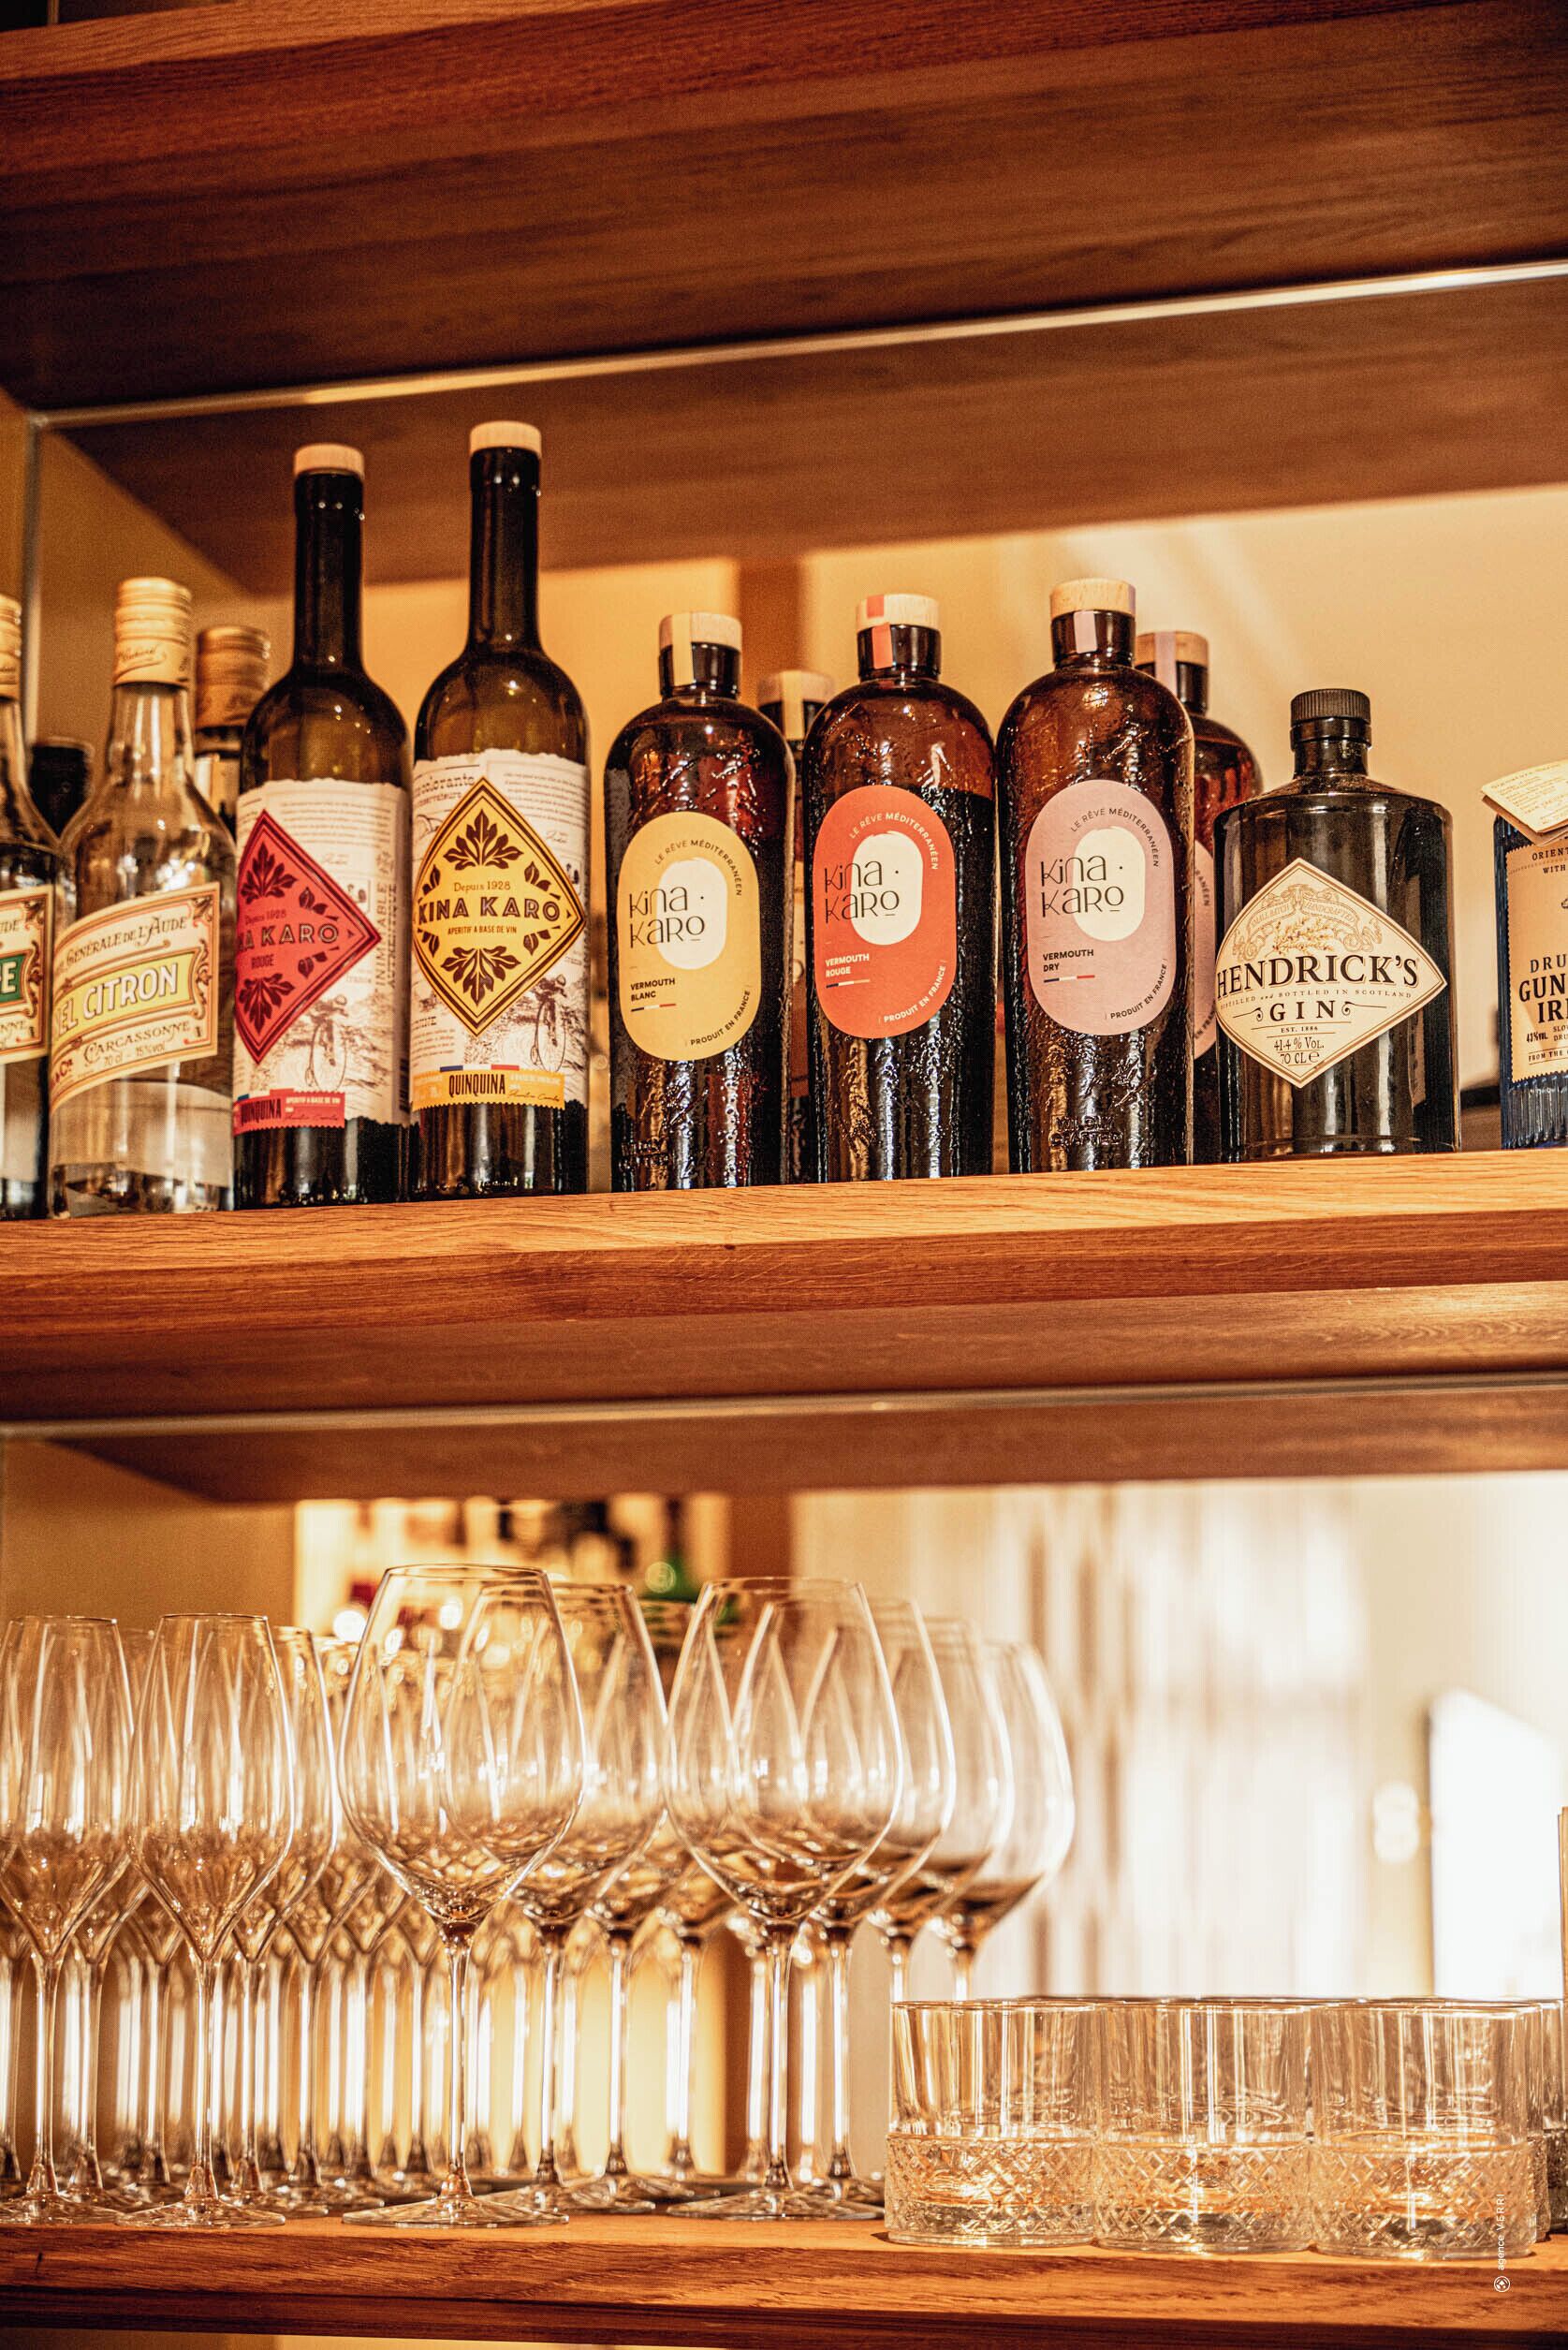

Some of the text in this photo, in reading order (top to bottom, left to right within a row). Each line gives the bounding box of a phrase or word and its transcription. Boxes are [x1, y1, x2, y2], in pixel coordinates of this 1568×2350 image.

[848, 812, 939, 870] LE RÊVE MÉDITERRANÉEN
[1070, 808, 1159, 867] LE RÊVE MÉDITERRANÉEN
[654, 853, 666, 865] LE
[690, 839, 742, 896] MÉDITERRANÉEN
[1543, 864, 1566, 874] WITH
[487, 881, 511, 890] 1928
[418, 896, 560, 925] KINA KARO
[261, 922, 339, 947] KARO
[479, 926, 494, 934] BASE
[496, 925, 505, 933] DE
[506, 924, 518, 933] VIN
[825, 953, 870, 967] VERMOUTH
[1042, 948, 1094, 962] VERMOUTH
[825, 966, 851, 978] ROUGE
[1042, 962, 1060, 973] DRY
[1216, 955, 1418, 1000] HENDRICK'S
[82, 962, 178, 1020] CITRON
[630, 977, 676, 991] VERMOUTH
[884, 965, 945, 1022] PRODUIT EN FRANCE
[1110, 963, 1167, 1019] PRODUIT EN FRANCE
[1279, 990, 1329, 998] BOTTLED
[1355, 990, 1412, 999] SCOTLAND
[631, 990, 656, 1002] BLANC
[690, 990, 750, 1046] PRODUIT EN FRANCE
[1269, 1000, 1336, 1022] GIN
[1279, 1052, 1292, 1065] 70
[448, 1074, 506, 1098] QUINQUINA
